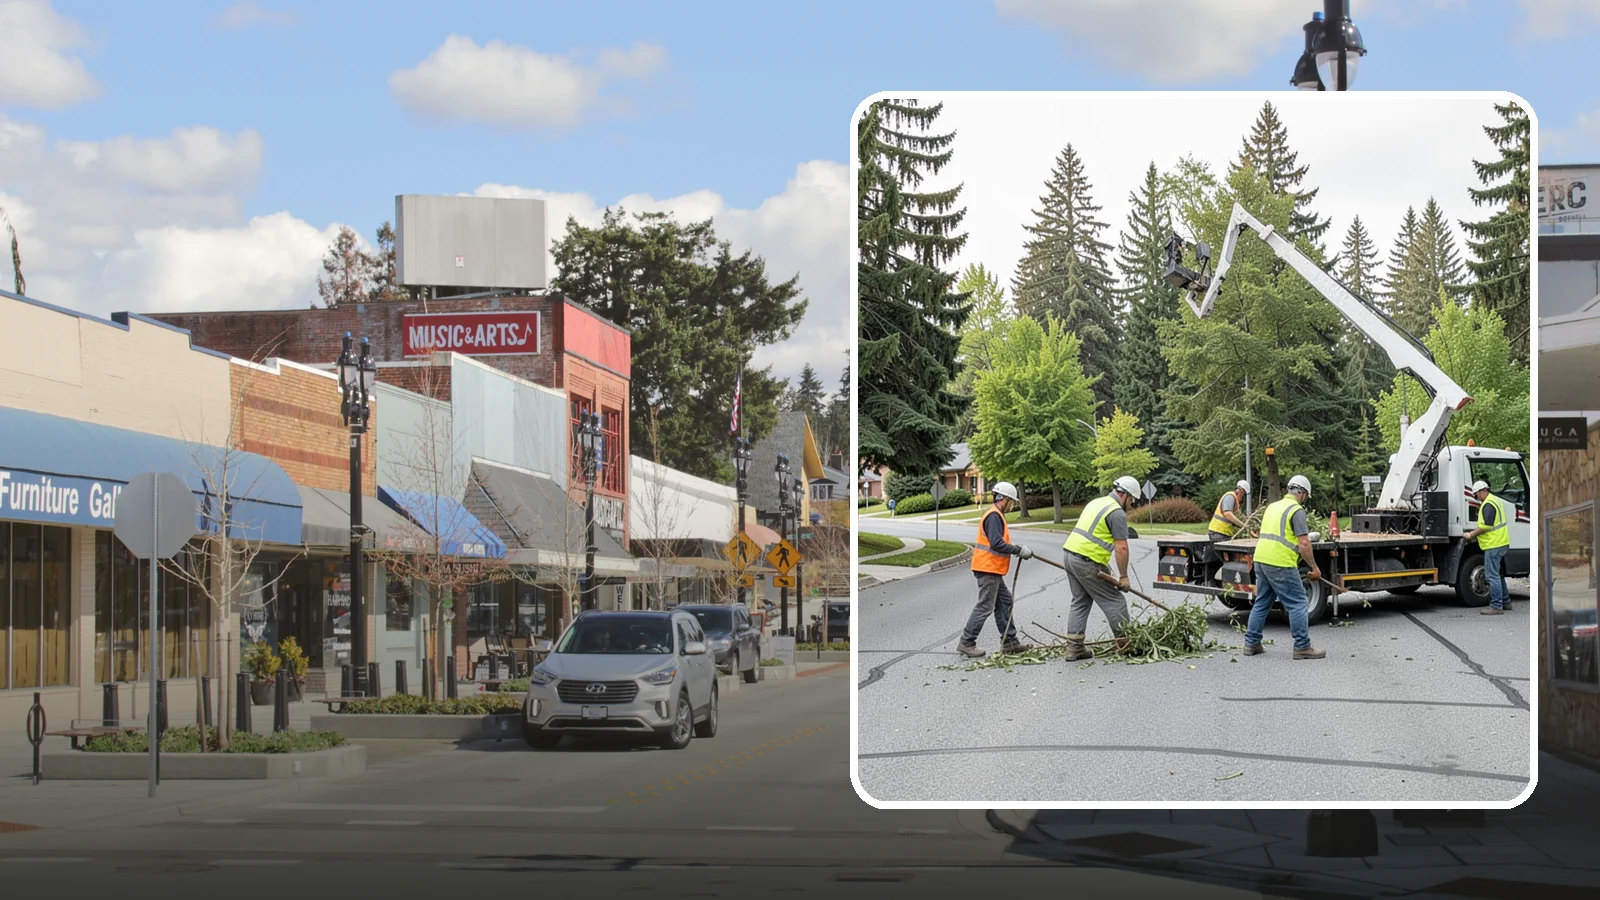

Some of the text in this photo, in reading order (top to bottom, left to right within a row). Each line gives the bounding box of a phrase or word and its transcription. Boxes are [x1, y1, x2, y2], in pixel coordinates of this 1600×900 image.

[408, 323, 520, 349] MUSIC&ARTS
[1540, 427, 1577, 436] UGA
[0, 471, 79, 515] Furniture
[453, 562, 480, 574] SUSHI
